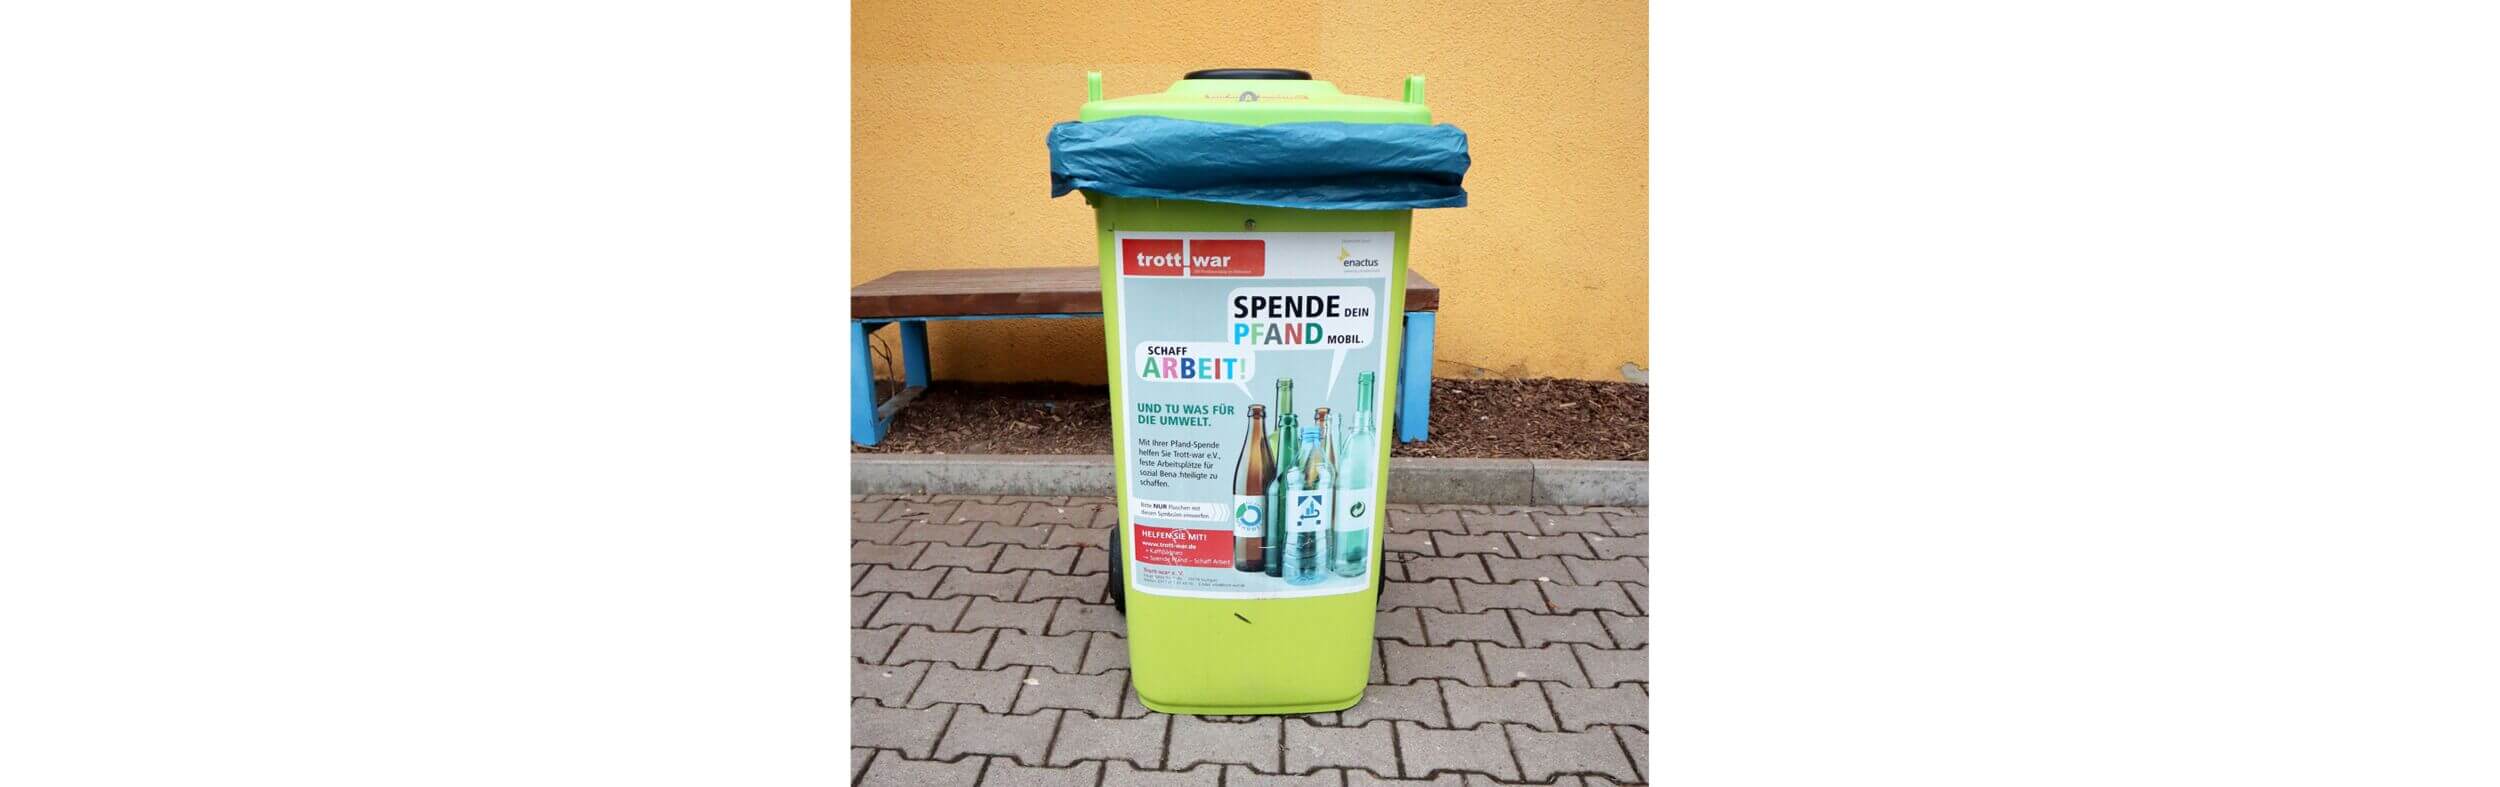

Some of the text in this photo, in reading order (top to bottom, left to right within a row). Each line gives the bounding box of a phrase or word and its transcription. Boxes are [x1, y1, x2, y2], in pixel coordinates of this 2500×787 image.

[1343, 258, 1379, 267] enactus
[1234, 295, 1369, 318] SPENDE DEIN
[1234, 322, 1364, 345] PFAND MOBIL.
[1148, 346, 1188, 356] SCHAFF
[1142, 356, 1246, 380] ARBEIT!
[1137, 403, 1235, 415] UND TU WAS FÜR
[1138, 415, 1212, 427] DIE UMWELT.
[1138, 438, 1150, 446] Mit
[1170, 440, 1220, 449] Pfand-Spende
[1138, 448, 1160, 456] helfen
[1161, 449, 1171, 457] Sie
[1139, 469, 1158, 477] sozial
[1142, 530, 1171, 539] HELFEN
